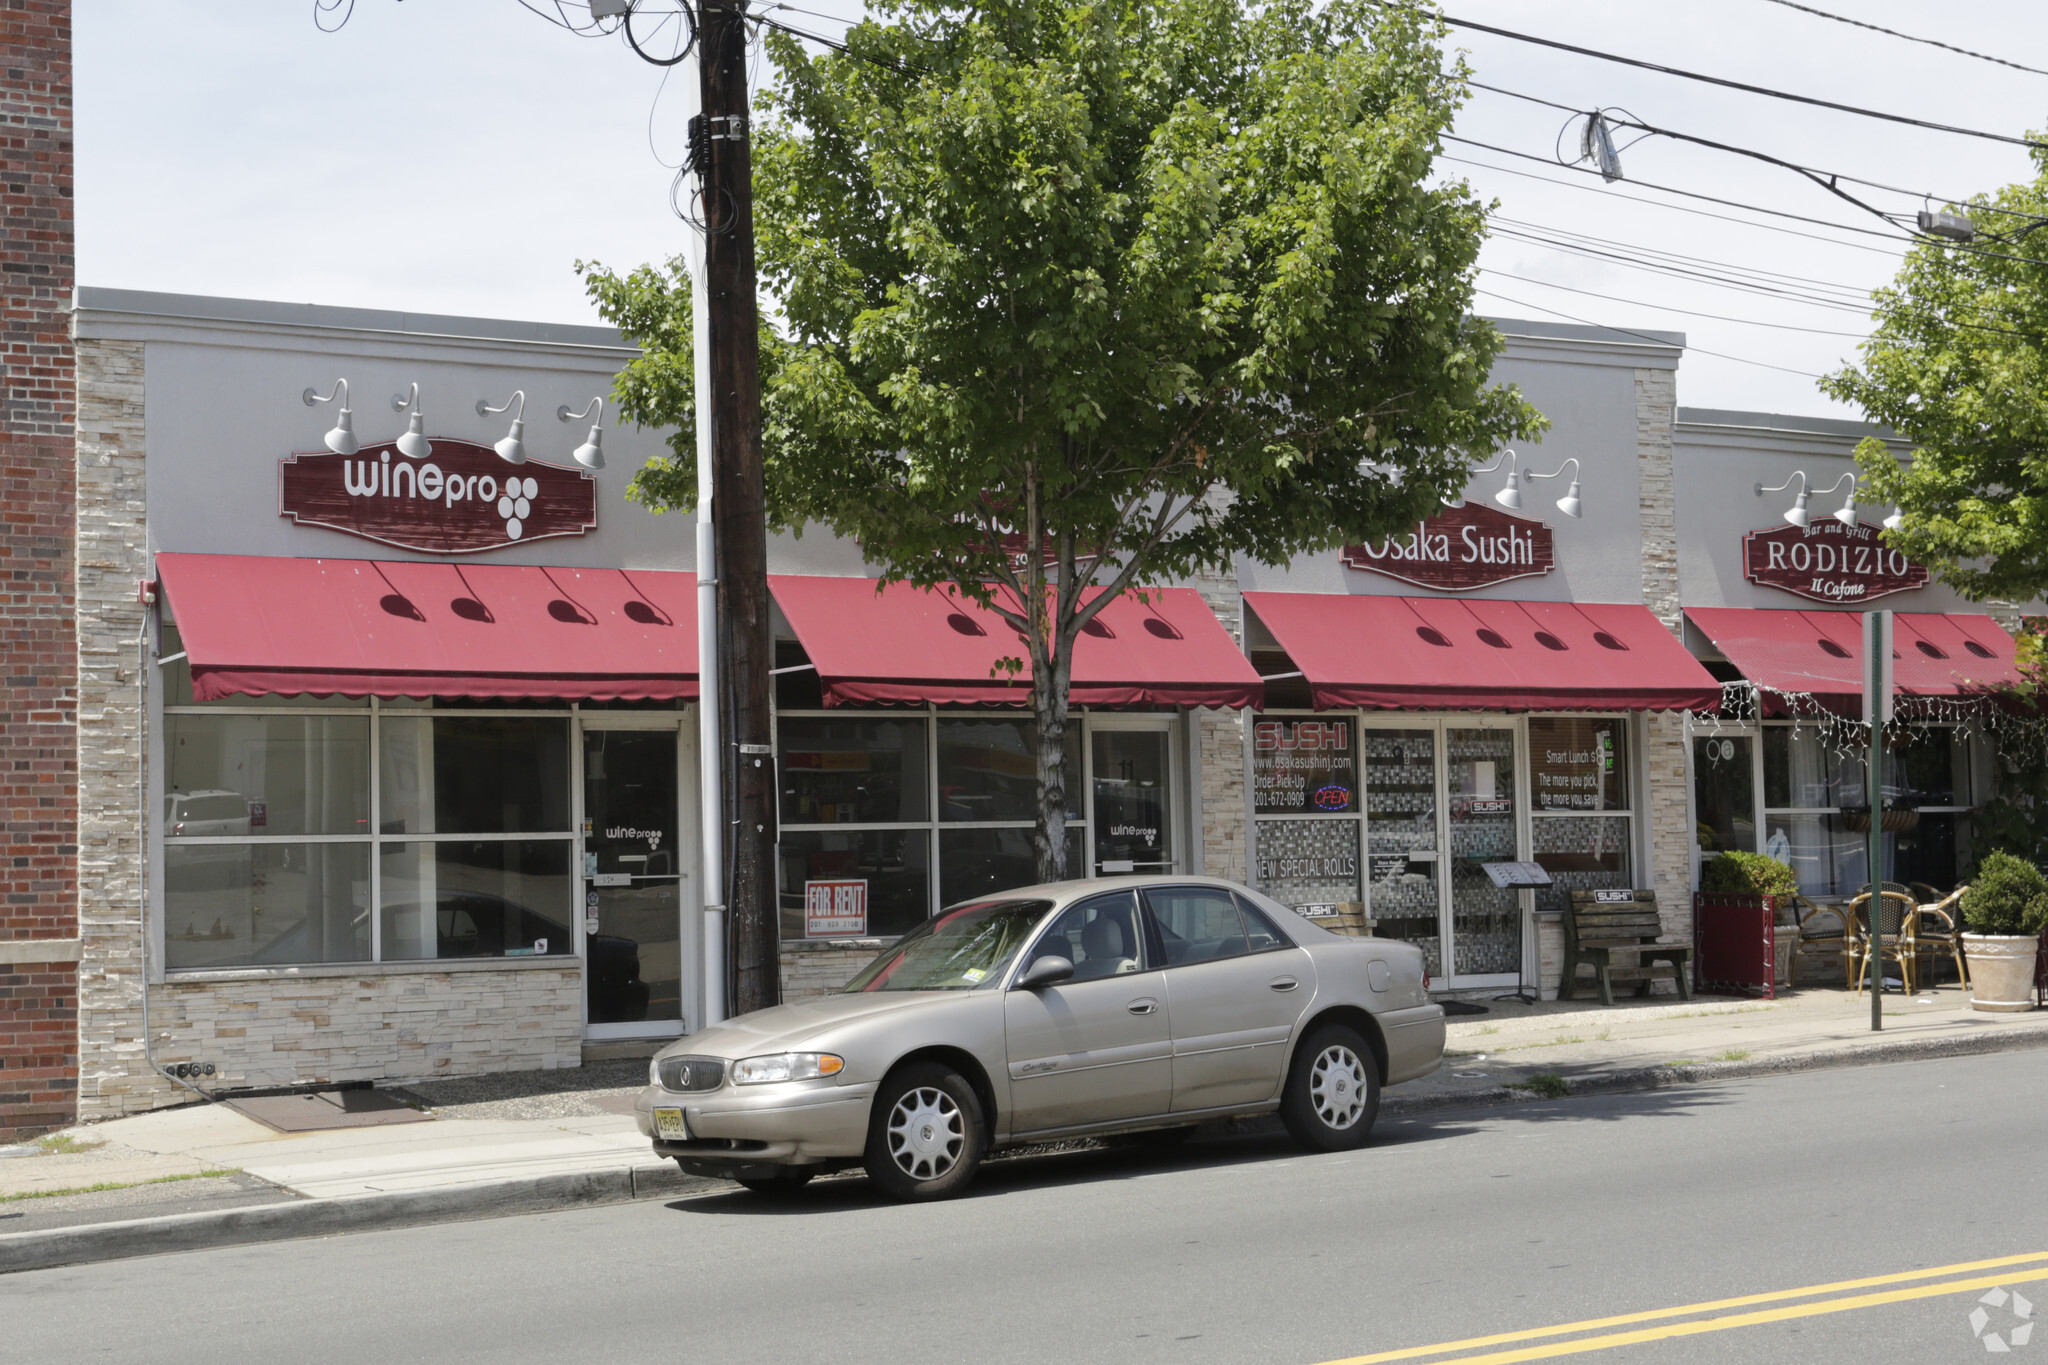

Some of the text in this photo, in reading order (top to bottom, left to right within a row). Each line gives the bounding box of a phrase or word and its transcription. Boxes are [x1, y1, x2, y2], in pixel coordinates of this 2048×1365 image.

[344, 451, 498, 508] winepro
[1802, 521, 1872, 541] Bar and Grill
[1461, 525, 1534, 565] Sushi
[1767, 541, 1909, 577] RODIZIO
[1810, 578, 1865, 600] Il Cafone
[1254, 721, 1347, 751] SUSHI
[1254, 755, 1352, 772] www.osakasushinj.com
[1546, 749, 1568, 763] Smart
[1569, 749, 1589, 763] Lunch
[1254, 774, 1305, 791] Order Pick-Up
[1538, 772, 1551, 787] The
[1553, 775, 1569, 787] more
[1570, 775, 1582, 790] you
[1255, 791, 1305, 806] 201-672-0909
[1314, 789, 1350, 805] OPEN
[1540, 791, 1552, 805] the
[1553, 794, 1569, 805] more
[1570, 794, 1582, 808] you
[1473, 802, 1505, 811] SUSHI
[1256, 860, 1277, 878] NEW
[1280, 858, 1321, 878] SPECIAL
[1324, 857, 1355, 876] ROLLS
[809, 885, 864, 917] FOR RENT
[1596, 892, 1628, 901] SUSHI
[1295, 906, 1331, 916] SUSHI
